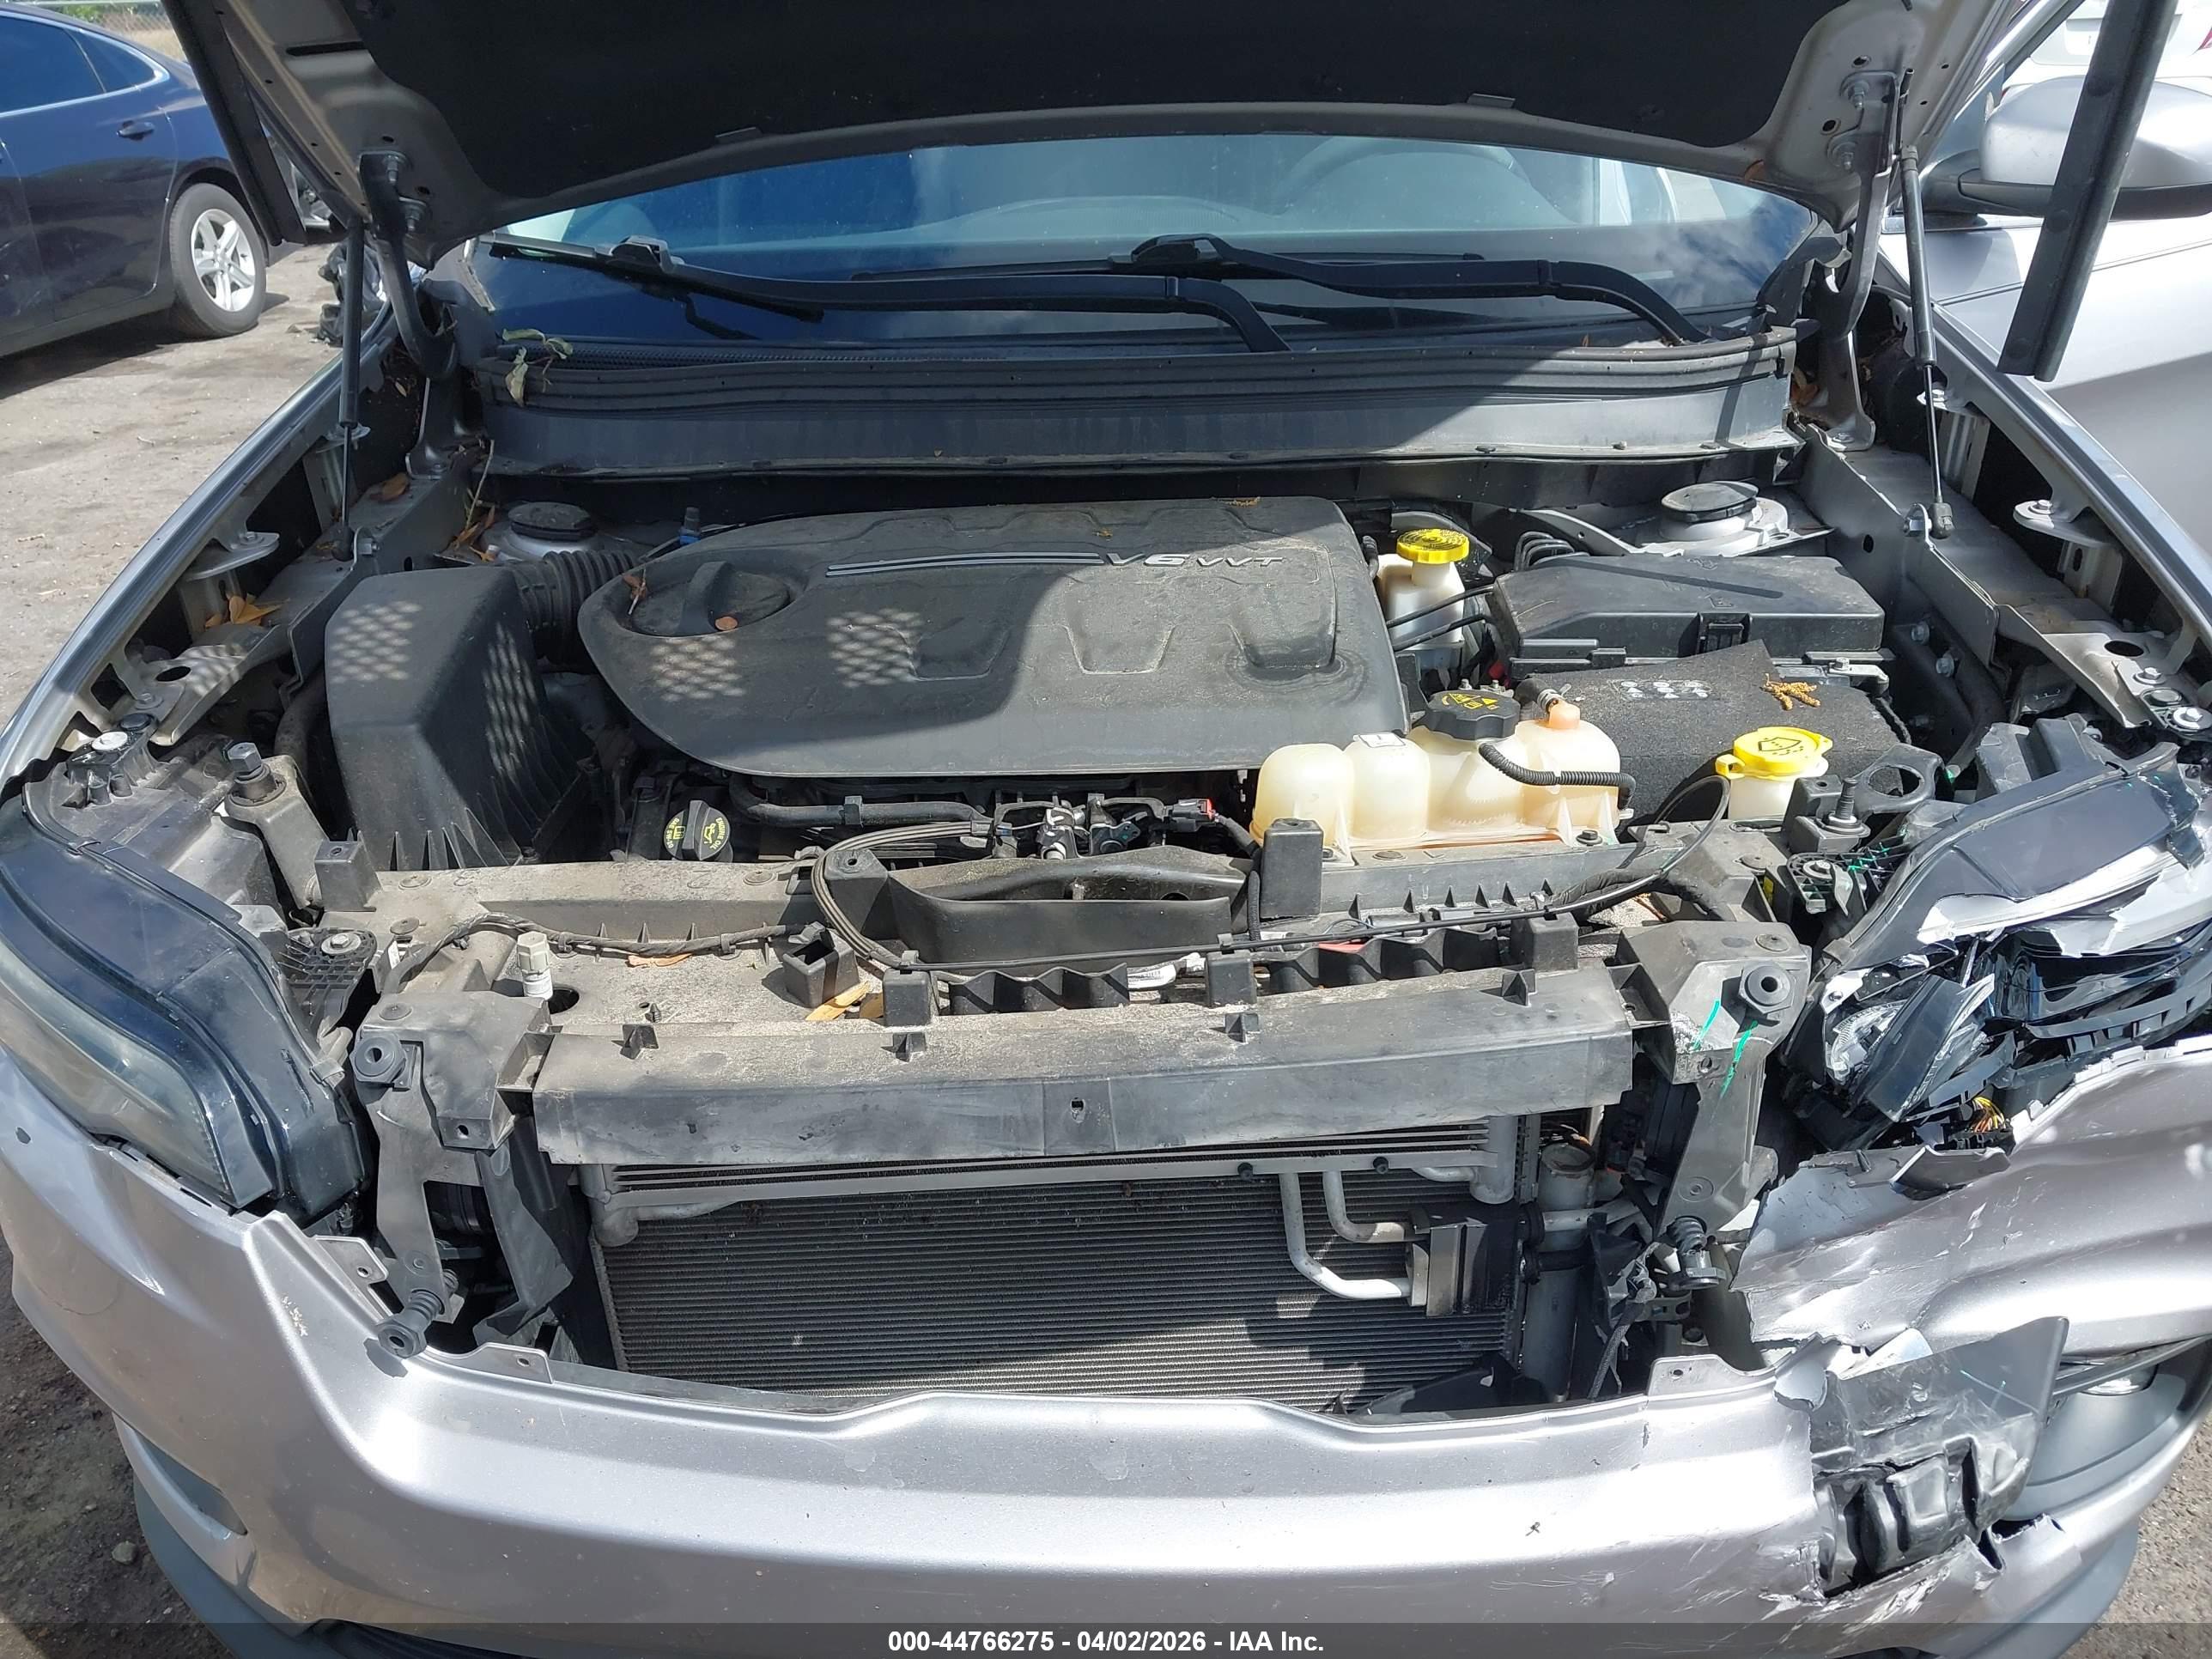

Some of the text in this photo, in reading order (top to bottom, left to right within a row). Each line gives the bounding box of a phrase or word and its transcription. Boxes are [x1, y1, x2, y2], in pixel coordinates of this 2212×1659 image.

[1107, 552, 1284, 568] V6 VVT
[668, 817, 680, 830] SAE
[709, 817, 726, 850] ENGINE OIL
